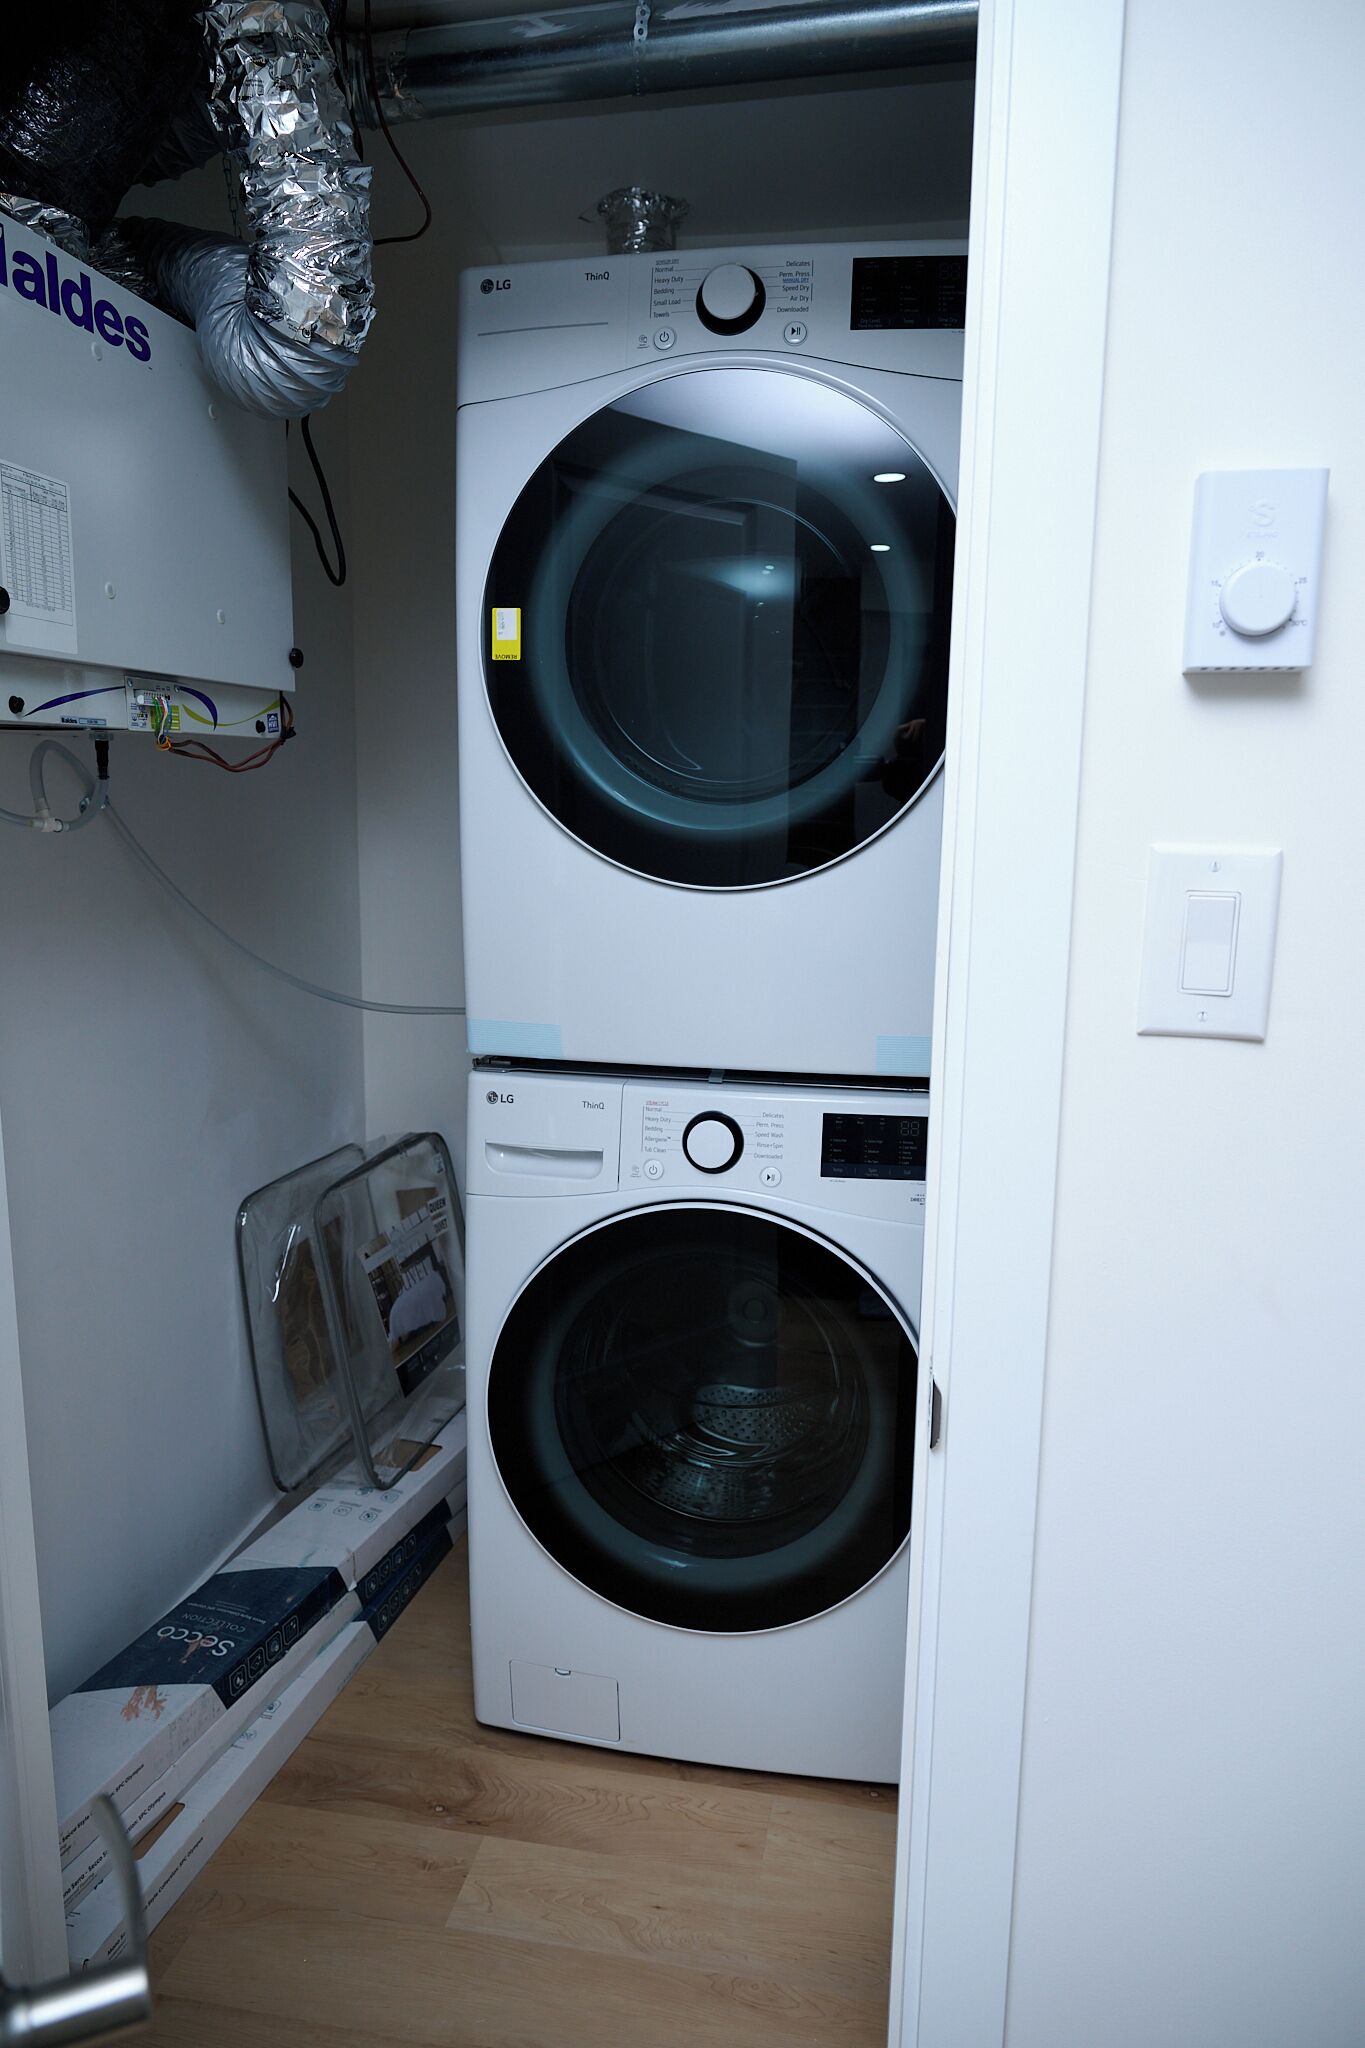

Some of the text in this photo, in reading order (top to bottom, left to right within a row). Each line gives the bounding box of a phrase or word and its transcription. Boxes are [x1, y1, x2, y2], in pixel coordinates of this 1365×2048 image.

[585, 271, 610, 281] ThinQ
[496, 279, 511, 291] LG
[653, 311, 670, 319] Towels
[500, 1094, 514, 1104] LG
[582, 1100, 605, 1110] ThinQ
[182, 1612, 246, 1633] COLLECTION
[156, 1626, 235, 1657] Secco
